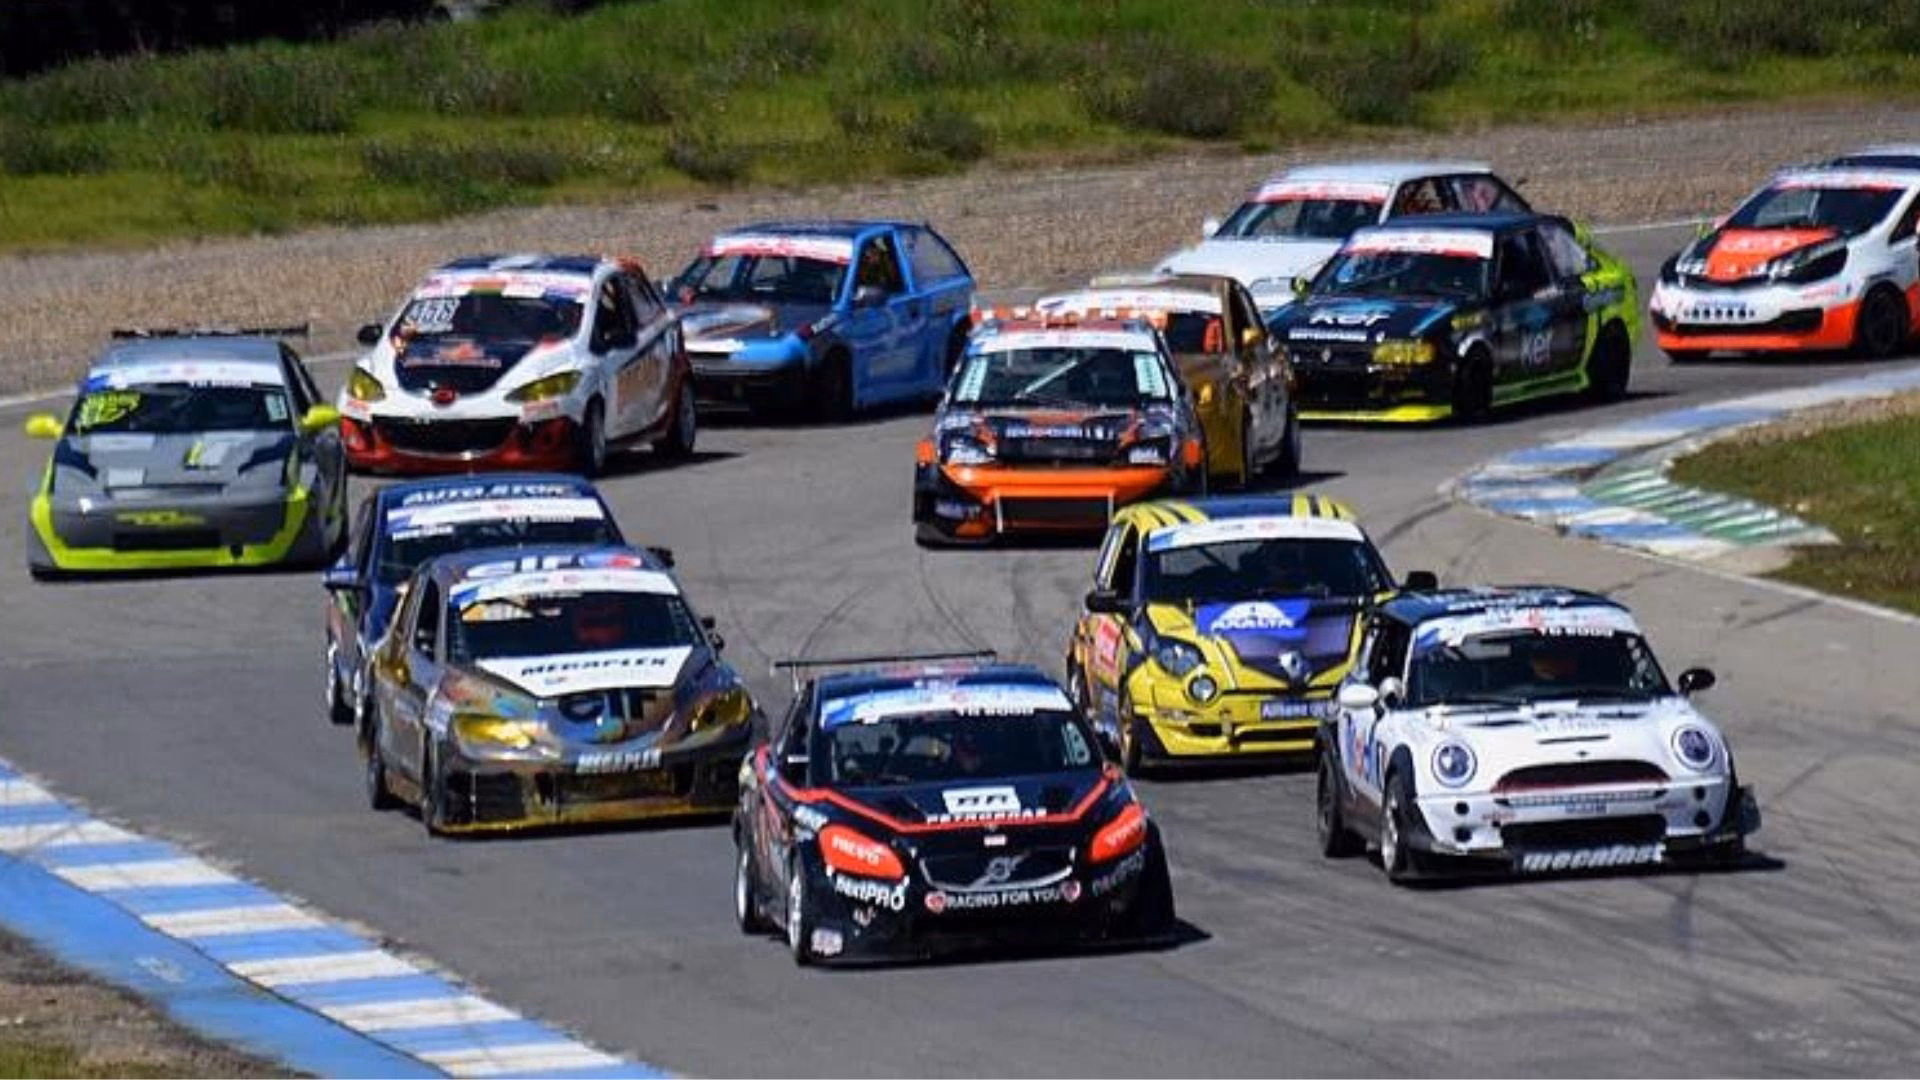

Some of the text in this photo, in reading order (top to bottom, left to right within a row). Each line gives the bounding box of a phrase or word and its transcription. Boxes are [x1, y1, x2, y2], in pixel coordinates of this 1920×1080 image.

[948, 886, 1062, 908] RACING FOR YOU
